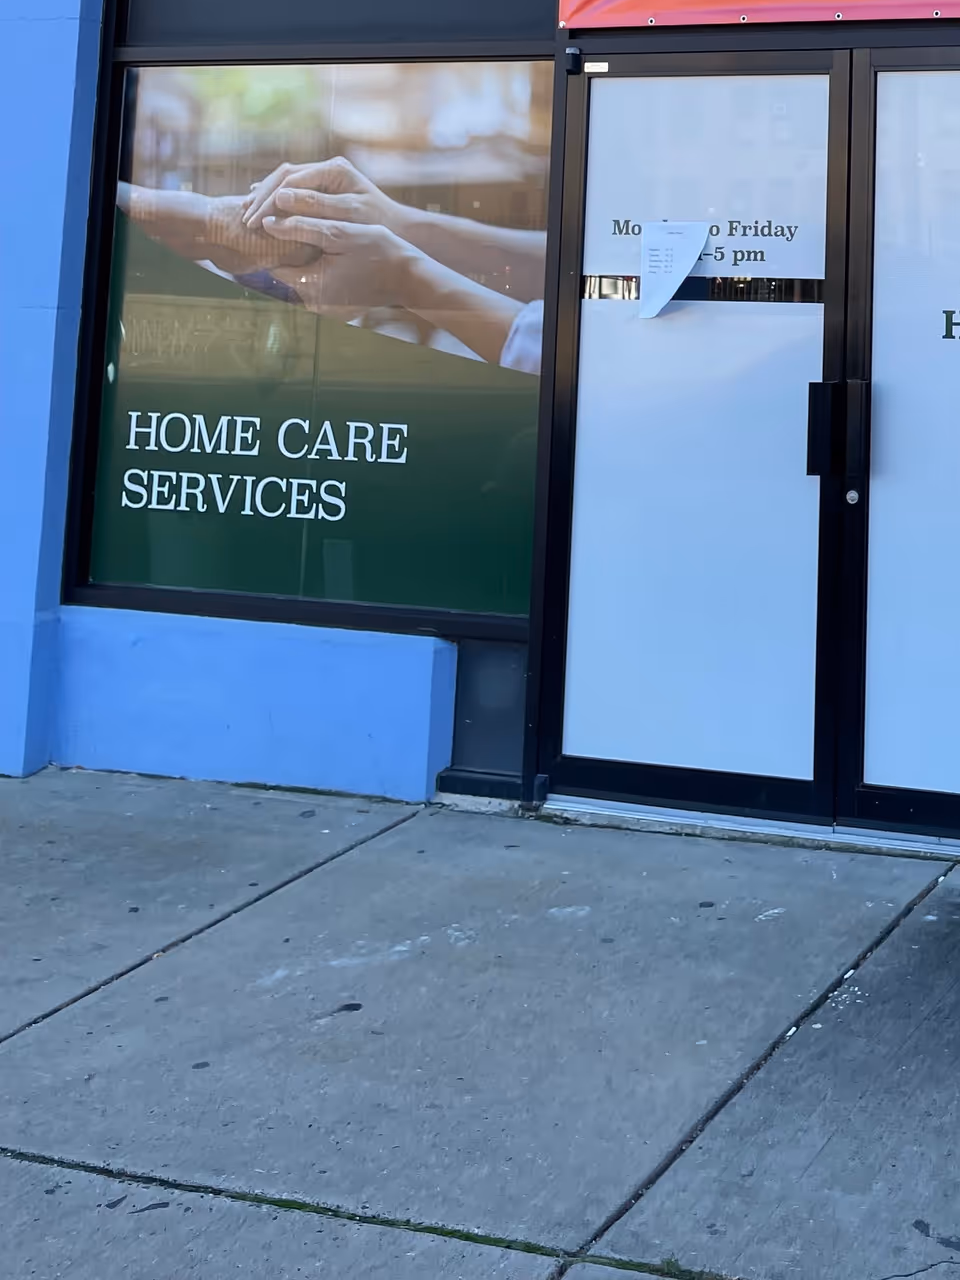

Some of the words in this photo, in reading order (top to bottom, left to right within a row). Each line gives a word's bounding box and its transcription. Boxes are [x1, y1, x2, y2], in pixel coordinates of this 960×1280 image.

[727, 219, 799, 242] Friday
[731, 249, 766, 267] pm
[125, 411, 261, 456] HOME
[276, 417, 409, 464] CARE
[121, 468, 347, 522] SERVICES
